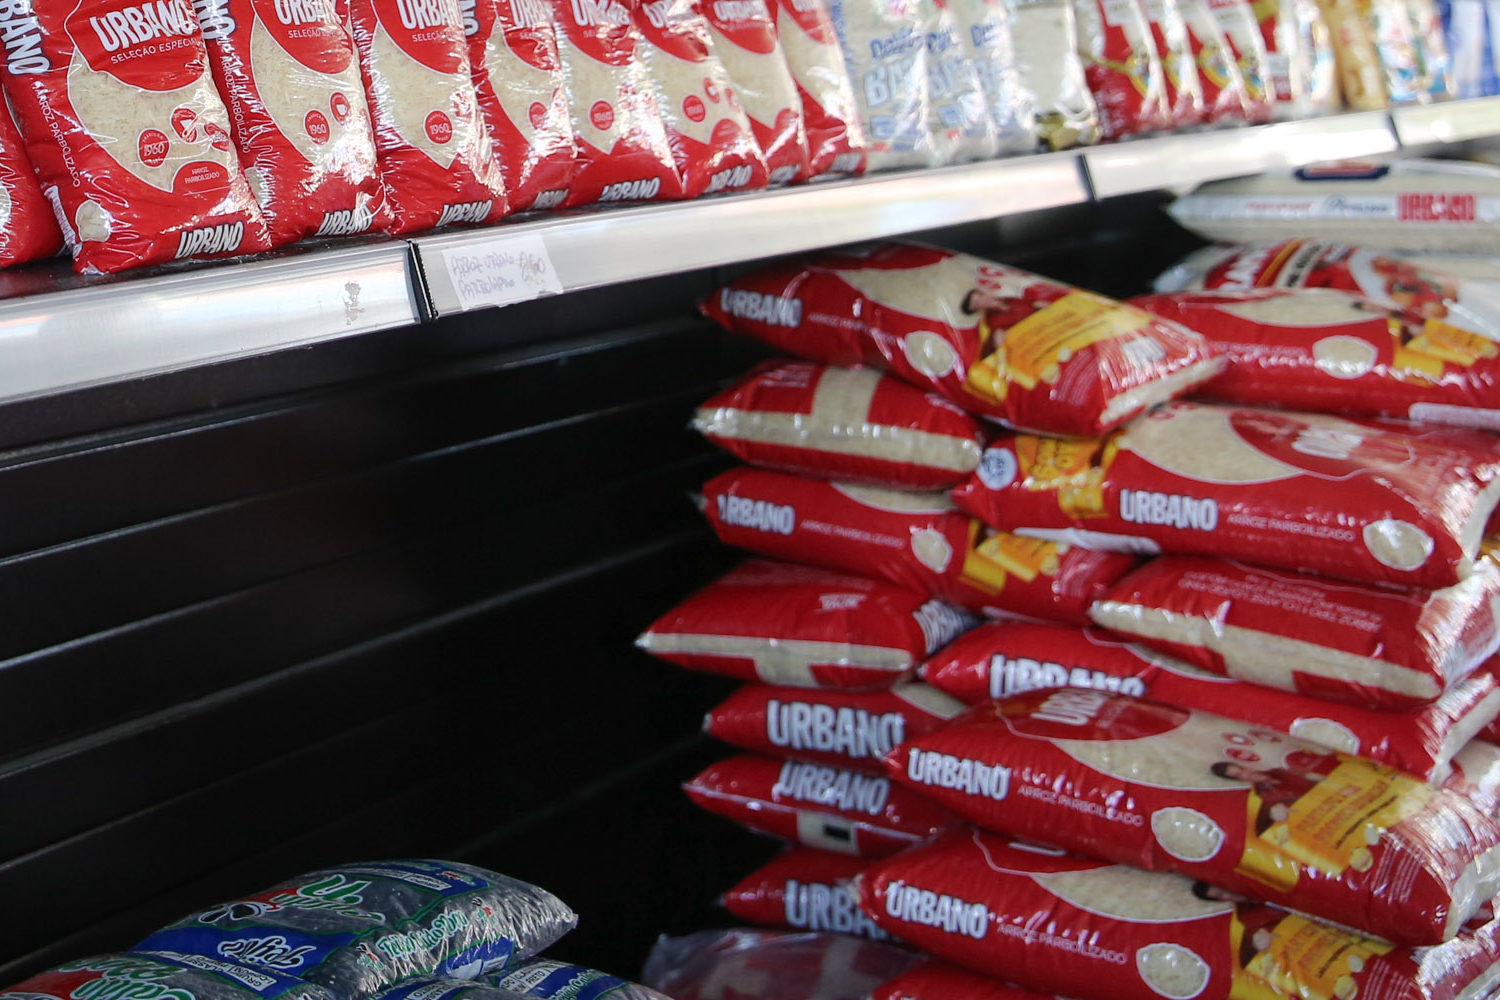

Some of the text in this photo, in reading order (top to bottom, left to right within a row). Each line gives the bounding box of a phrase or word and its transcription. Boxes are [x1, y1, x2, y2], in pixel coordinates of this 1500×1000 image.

[110, 44, 157, 65] SELEÇÃO
[309, 123, 327, 136] 1960
[174, 220, 246, 260] URBANO
[720, 286, 803, 328] URBANO
[1119, 487, 1219, 532] URBANO
[1268, 515, 1356, 542] PARBOILIZADO
[778, 761, 890, 815] URBANO
[906, 747, 1012, 800] URBANO
[885, 881, 989, 940] URBANO
[1040, 931, 1128, 965] PARBOILIZADO
